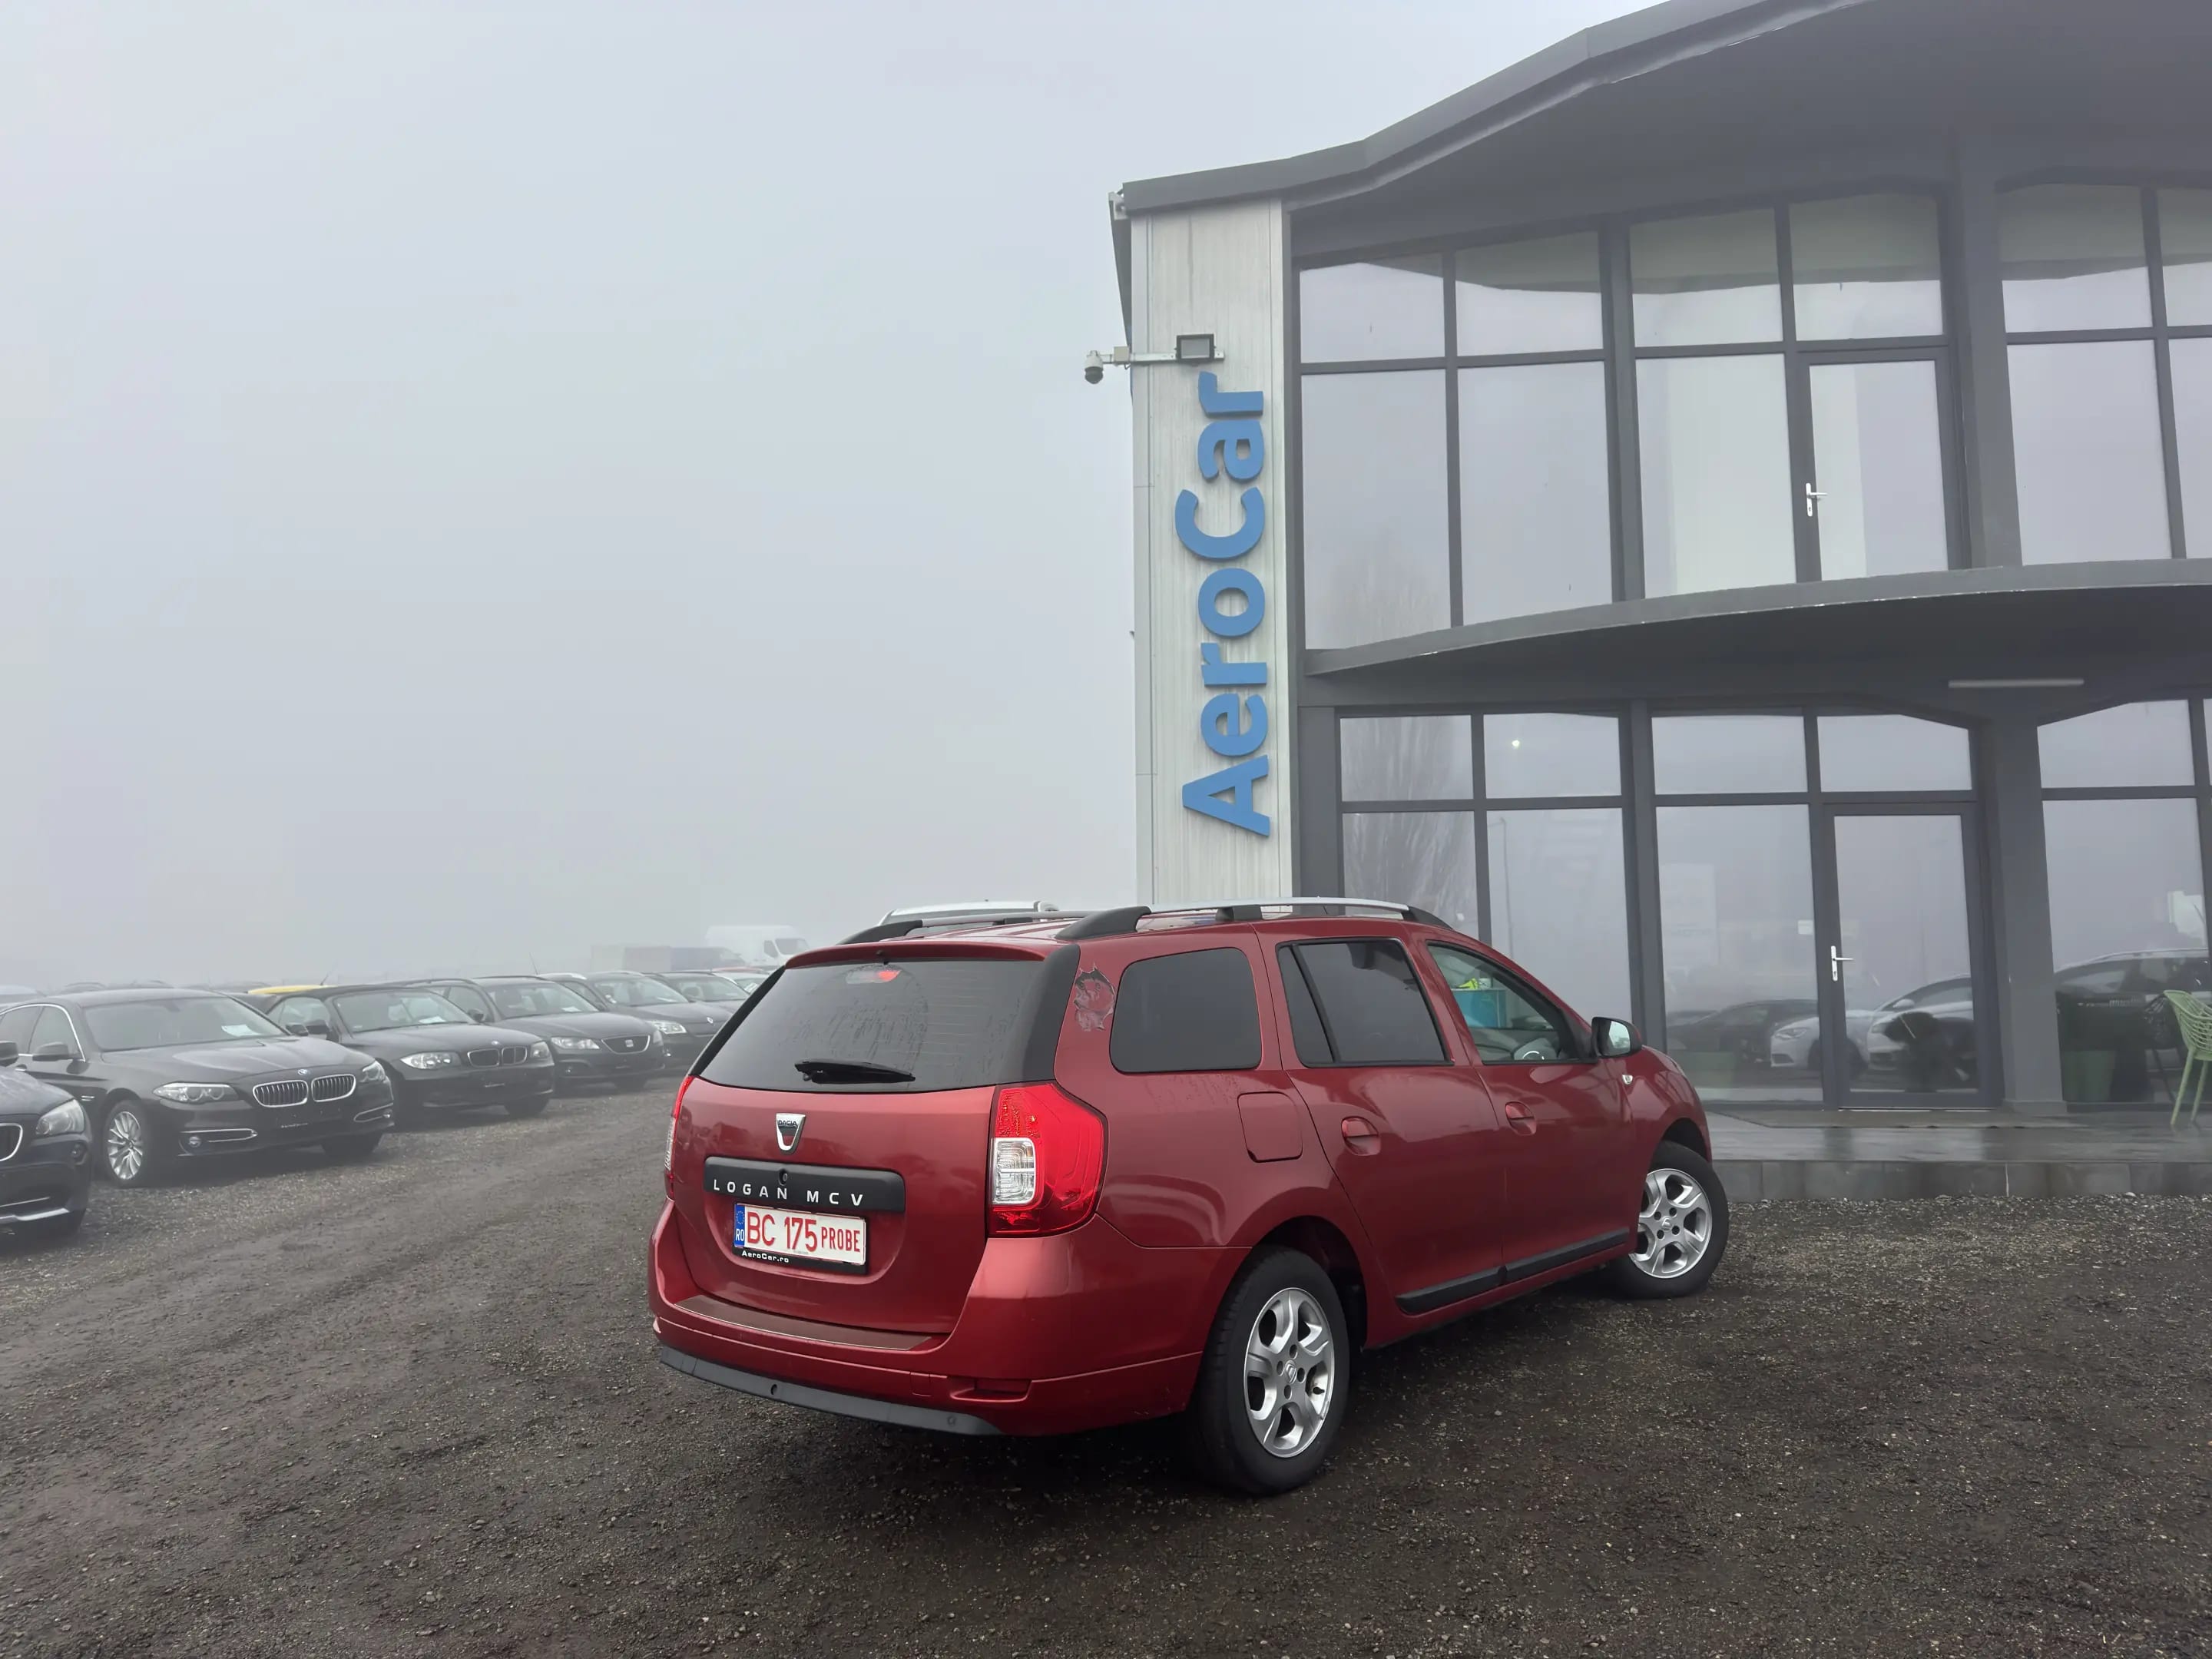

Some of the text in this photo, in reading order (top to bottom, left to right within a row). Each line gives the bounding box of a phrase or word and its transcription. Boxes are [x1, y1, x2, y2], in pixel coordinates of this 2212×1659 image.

[1174, 370, 1270, 837] AeroCar
[713, 1179, 863, 1206] LOGAN MCV
[735, 1229, 745, 1242] RO
[747, 1211, 860, 1253] BC 175 PROBE
[741, 1250, 790, 1263] AeroCar.ro
